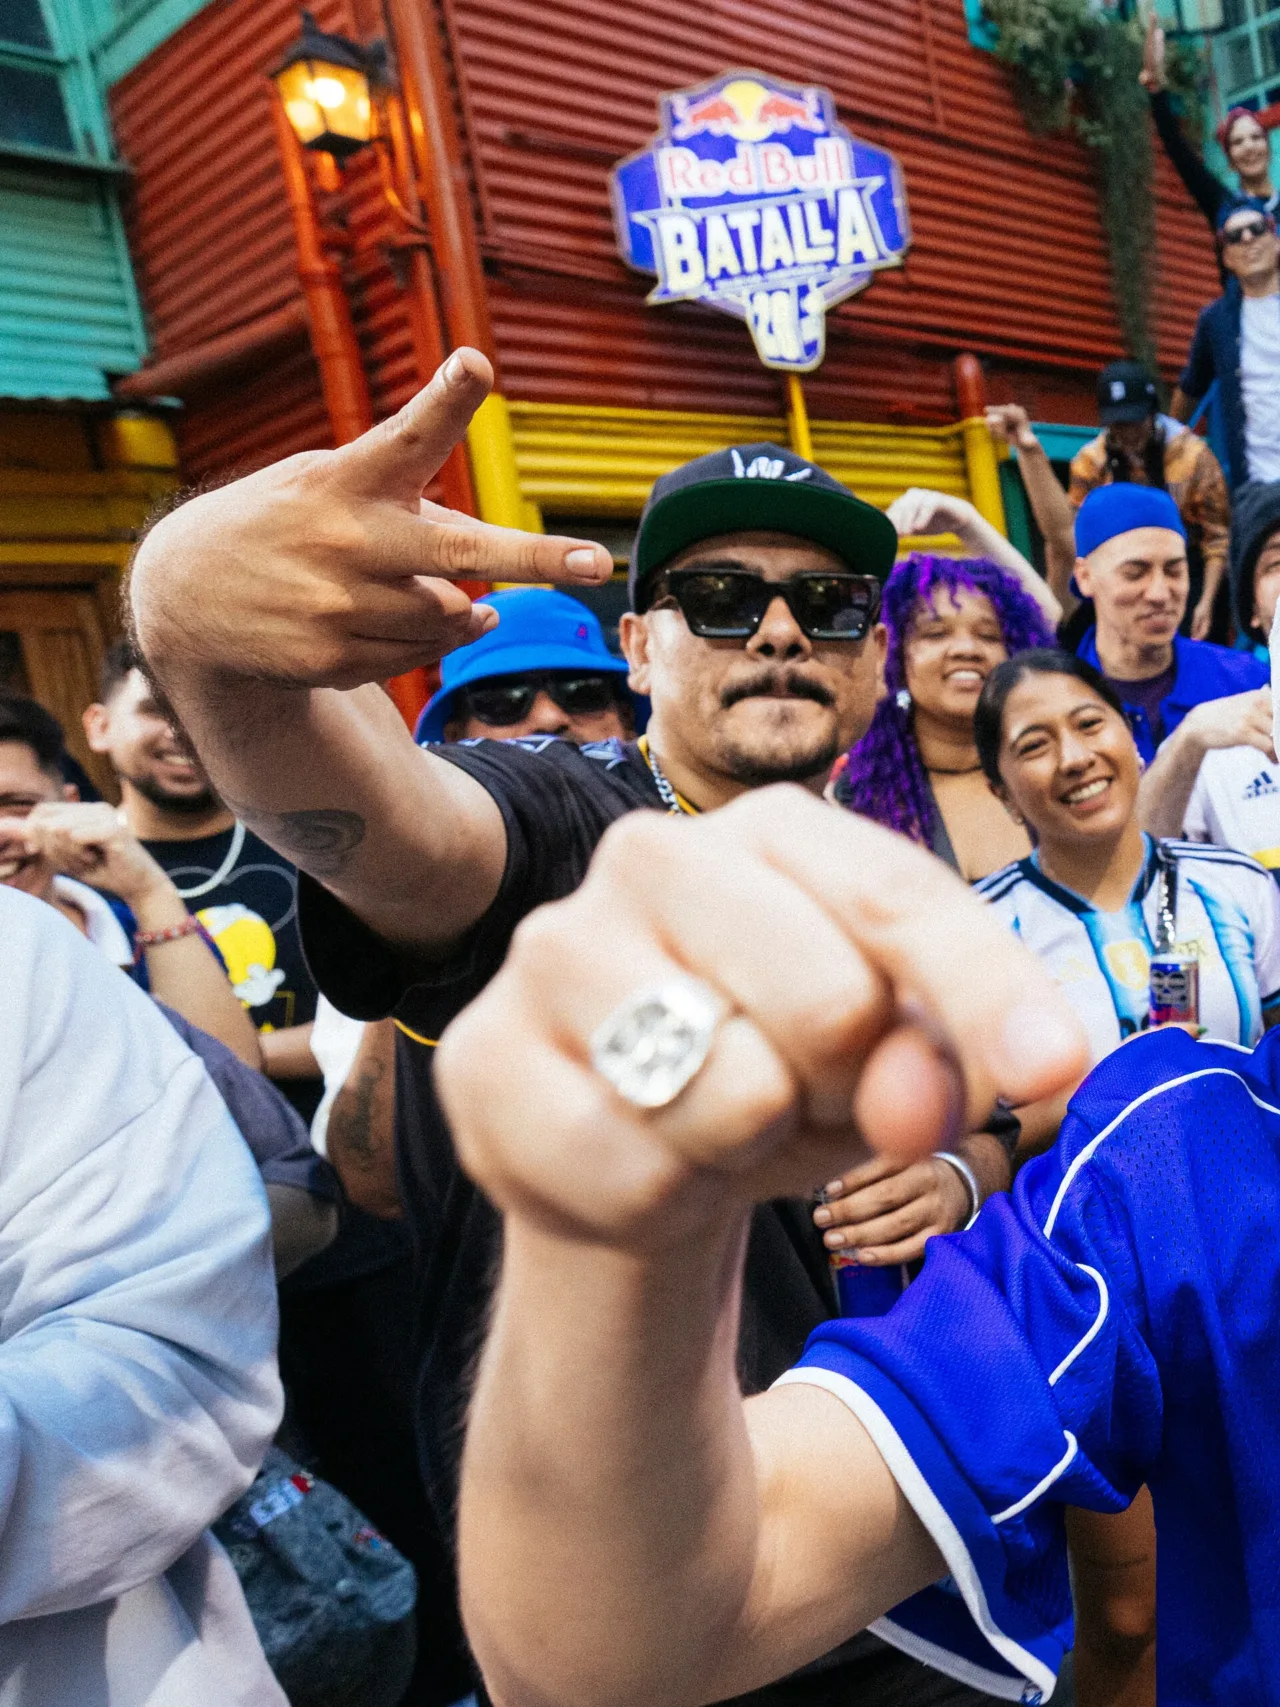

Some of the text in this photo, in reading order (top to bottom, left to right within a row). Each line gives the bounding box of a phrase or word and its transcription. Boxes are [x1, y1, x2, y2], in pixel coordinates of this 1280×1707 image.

[667, 142, 846, 191] Red Bull
[656, 188, 879, 292] BATALLA
